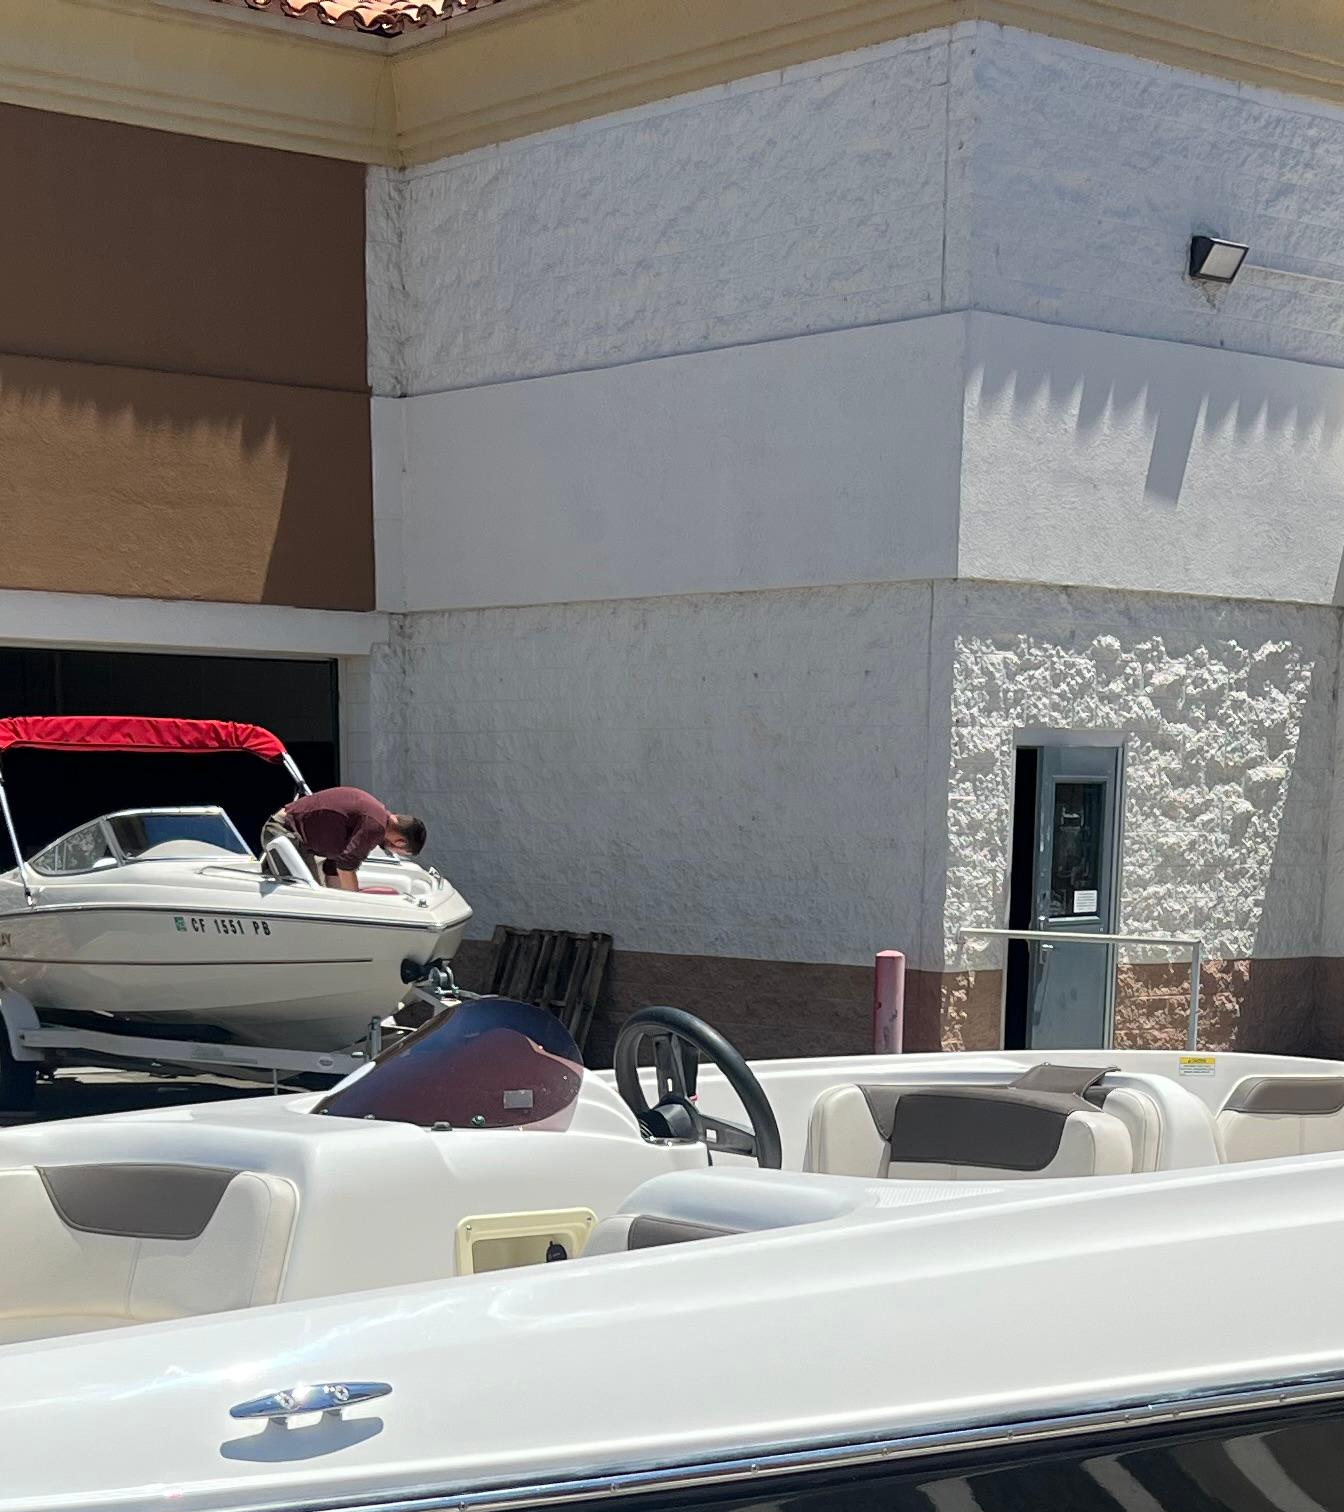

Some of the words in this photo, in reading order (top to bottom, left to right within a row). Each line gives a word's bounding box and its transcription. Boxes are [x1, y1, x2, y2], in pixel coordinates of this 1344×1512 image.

[191, 917, 206, 933] CF
[214, 919, 245, 935] 1551
[252, 920, 272, 936] PB
